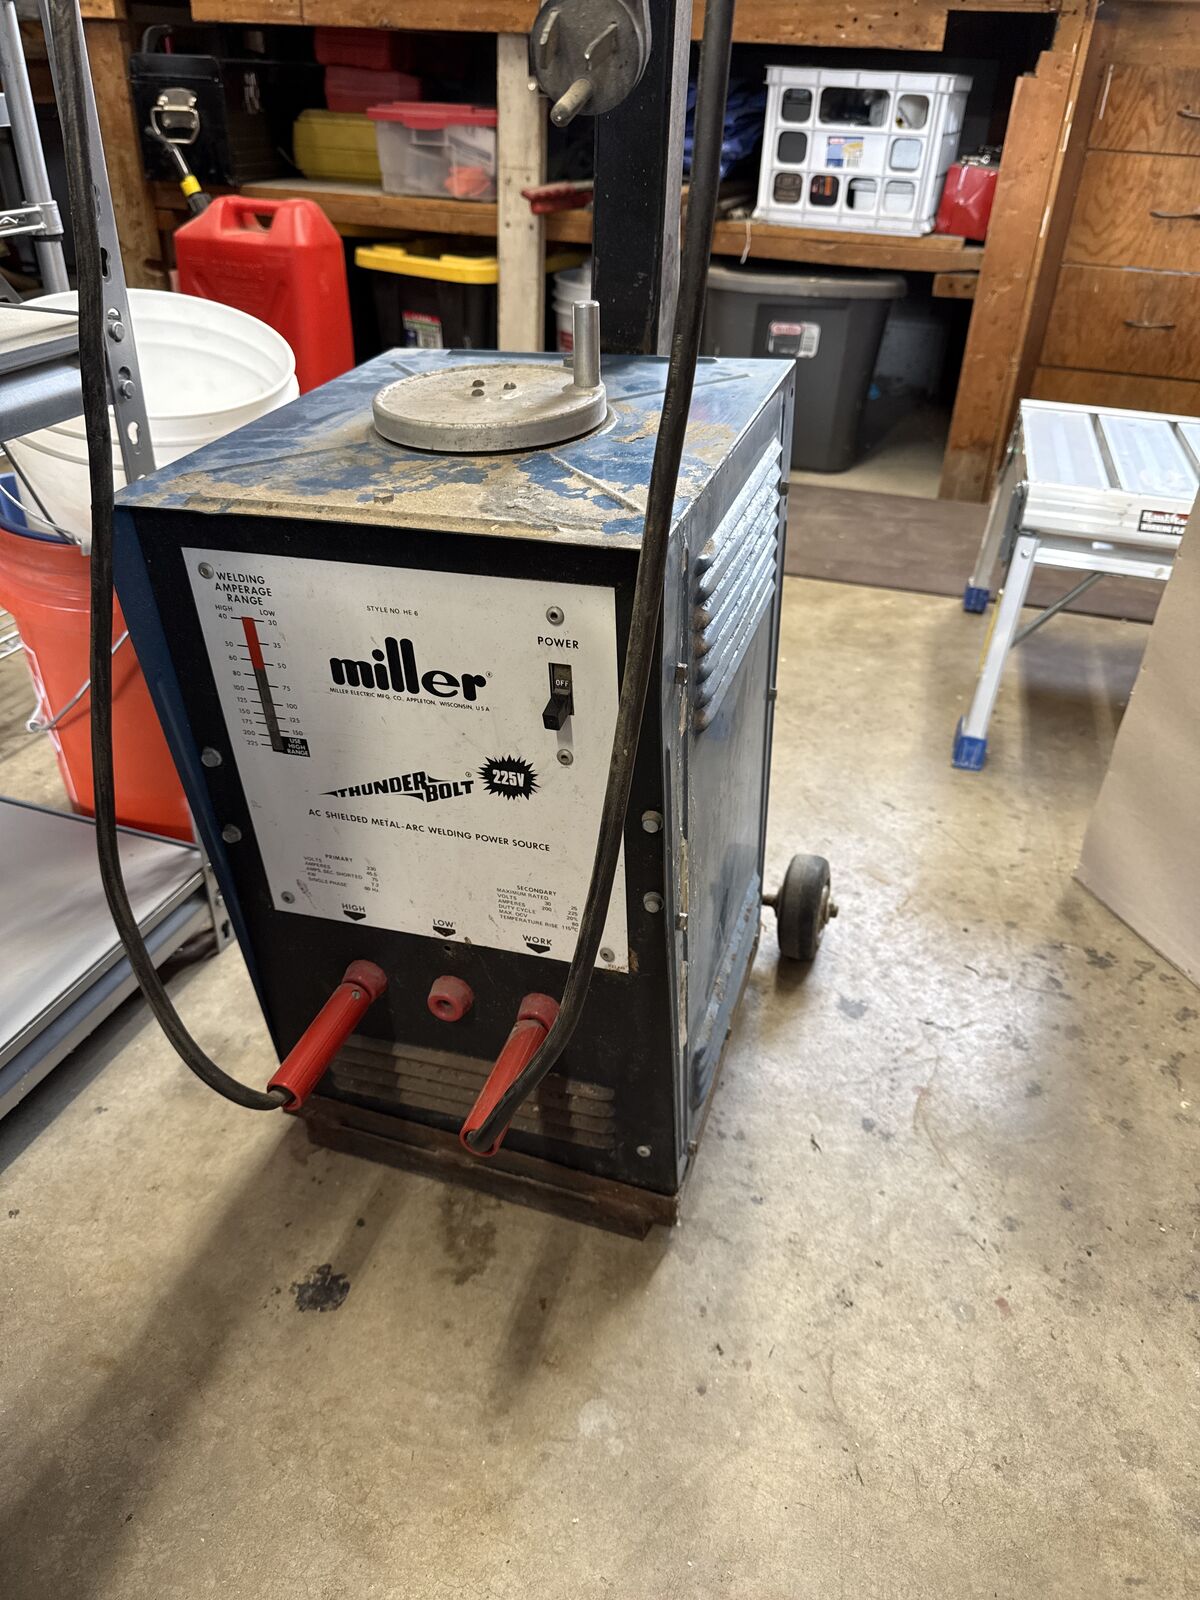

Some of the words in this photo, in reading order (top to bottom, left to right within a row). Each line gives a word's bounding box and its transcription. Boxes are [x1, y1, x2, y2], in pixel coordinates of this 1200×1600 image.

[216, 572, 265, 584] WELDING
[215, 583, 272, 596] AMPERAGE
[227, 594, 263, 605] RANGE
[215, 604, 233, 612] HIGH
[366, 605, 388, 613] STYLE
[537, 636, 579, 649] POWER
[329, 637, 487, 702] miller
[555, 679, 569, 687] OFF
[350, 690, 375, 698] ELECTRIC
[492, 769, 525, 788] 225V
[308, 809, 321, 817] AC
[325, 811, 368, 824] SHIELDED
[371, 818, 425, 832] METAL-ARC
[428, 826, 472, 840] WELDING
[475, 833, 509, 845] POWER
[512, 839, 550, 852] SOURCE
[325, 854, 352, 862] PRIMARY
[497, 887, 527, 897] MAXIMUM
[528, 893, 549, 901] RATED
[516, 885, 557, 896] SECONDARY
[341, 903, 366, 912] HIGH
[498, 899, 526, 907] AMPERES
[432, 918, 454, 928] LOW
[500, 914, 543, 926] TEMPERATURE
[522, 934, 552, 946] WORK
